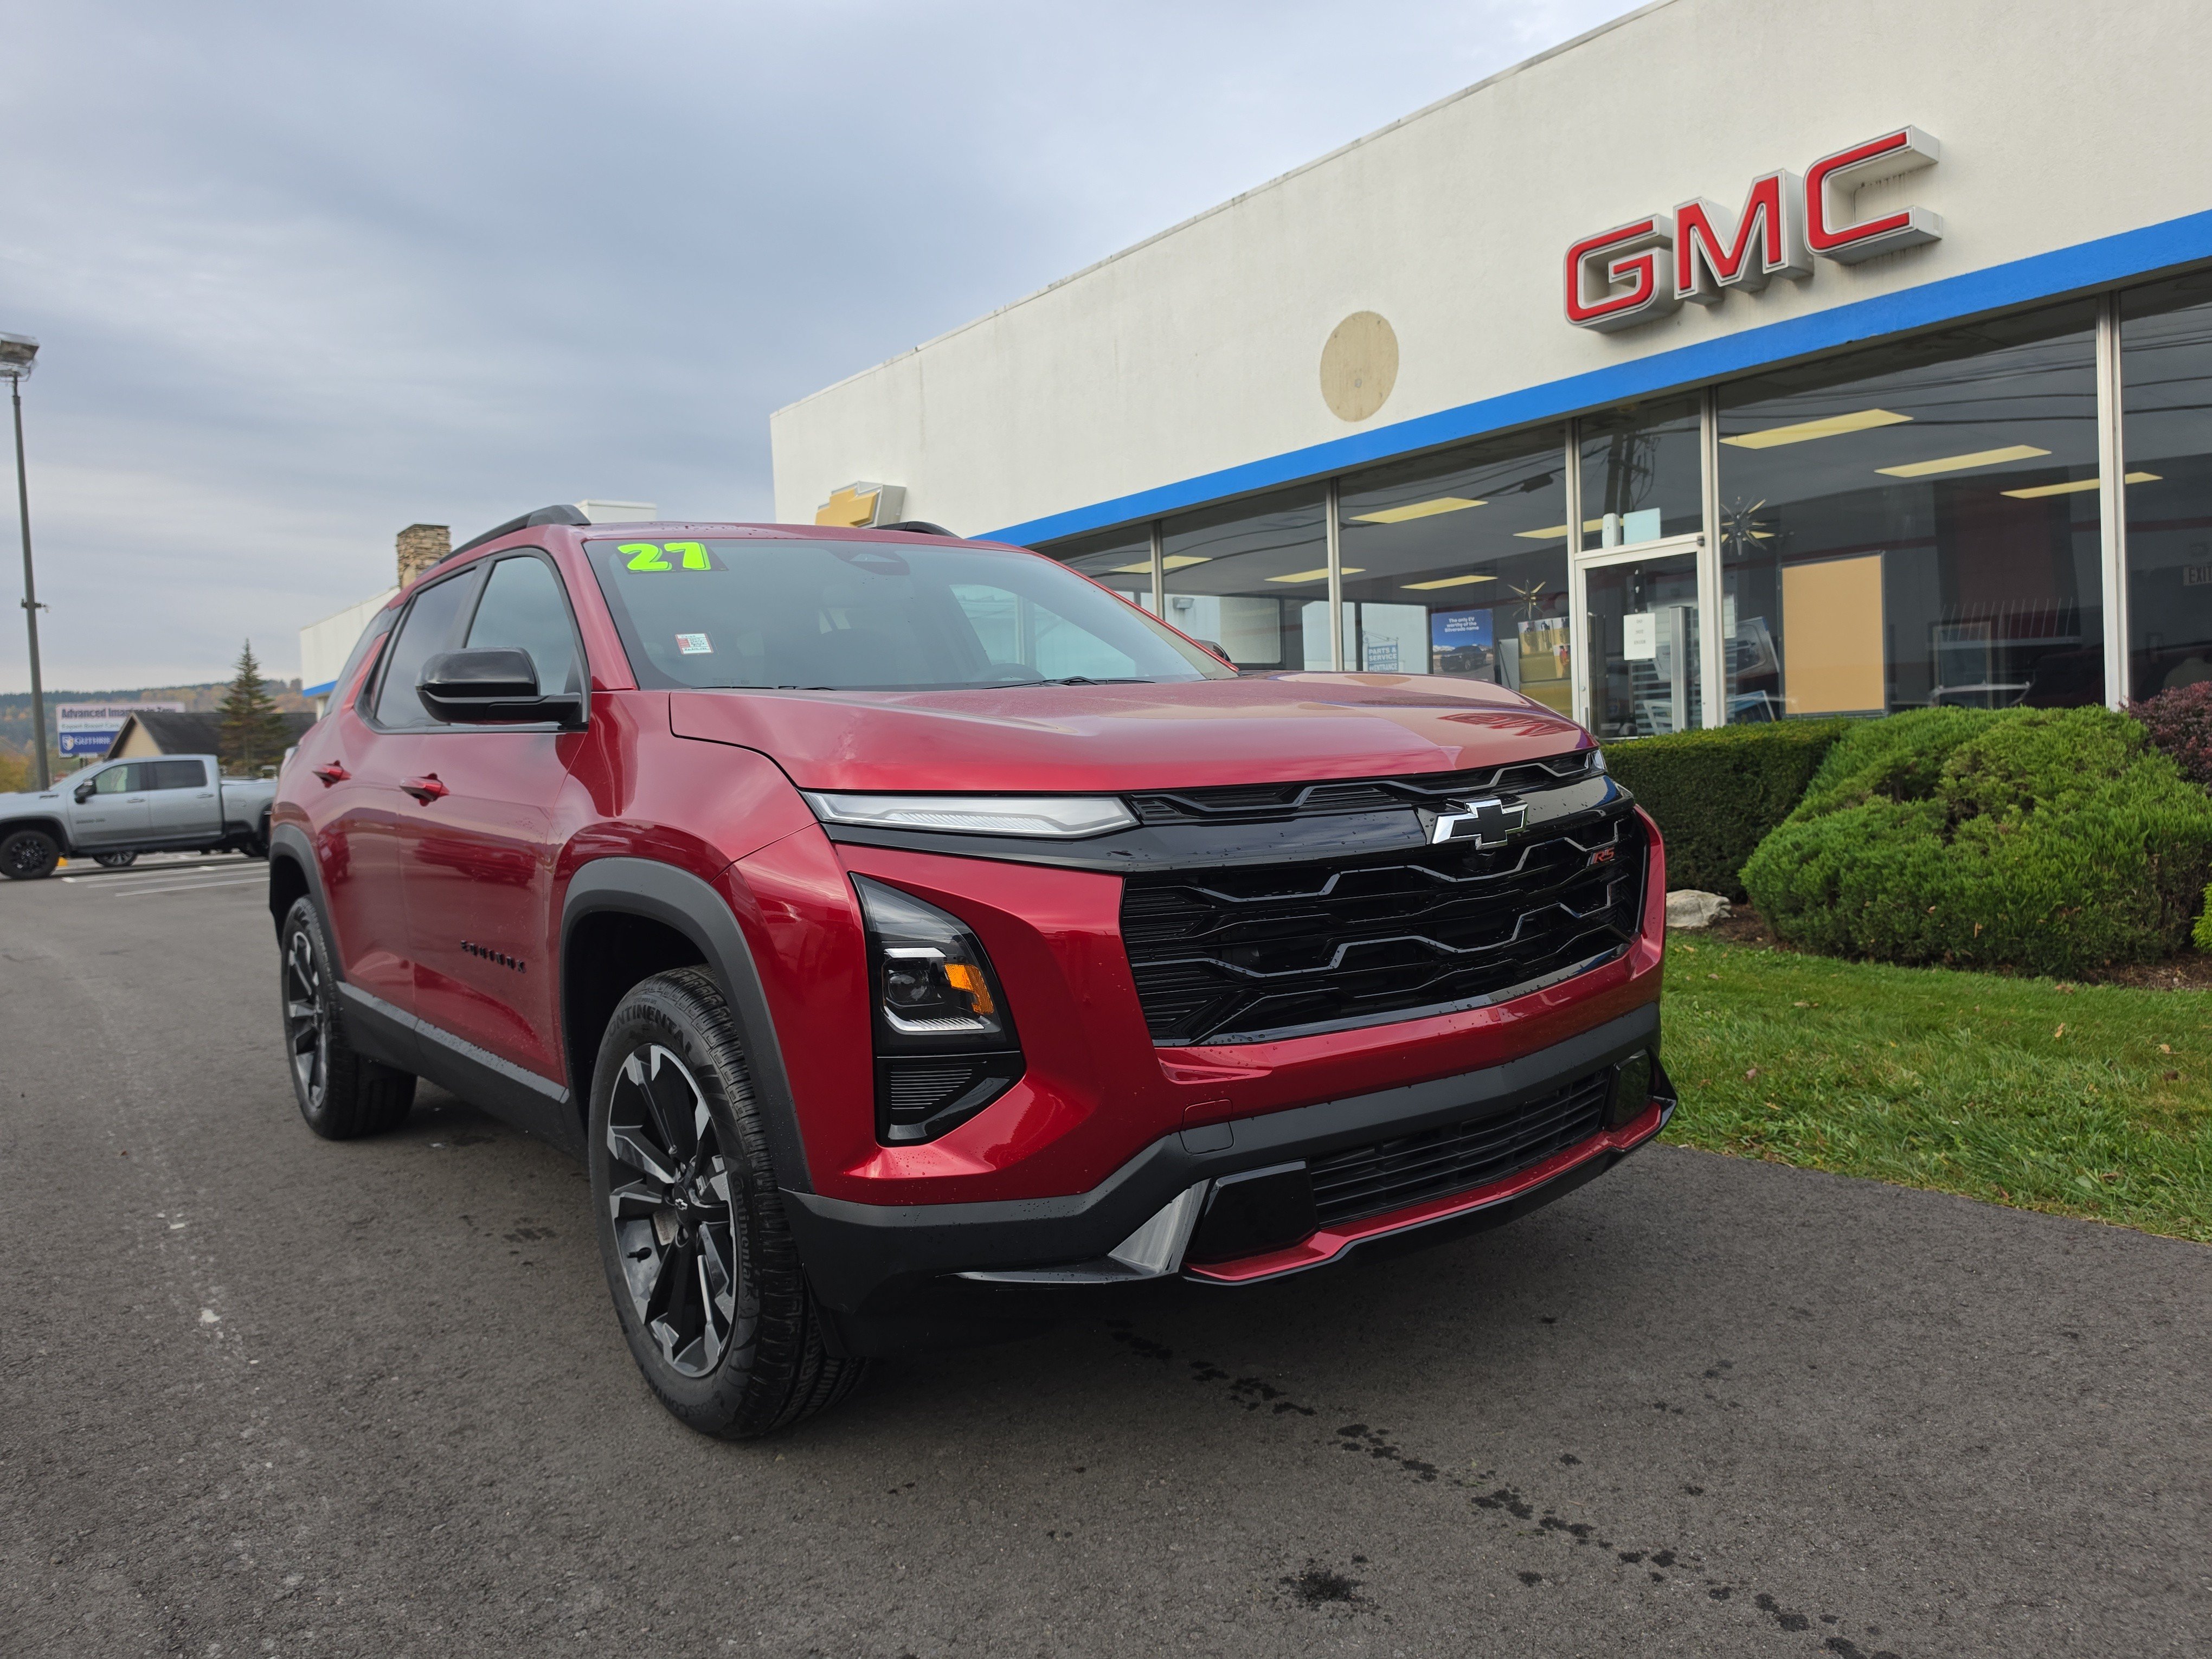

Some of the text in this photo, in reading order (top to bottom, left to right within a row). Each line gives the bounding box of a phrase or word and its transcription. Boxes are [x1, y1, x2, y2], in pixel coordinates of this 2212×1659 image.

[1564, 125, 1925, 329] GMC
[617, 542, 711, 571] 27
[1369, 653, 1397, 661] SERVICE
[61, 708, 106, 718] Advanced
[1593, 846, 1615, 864] RS
